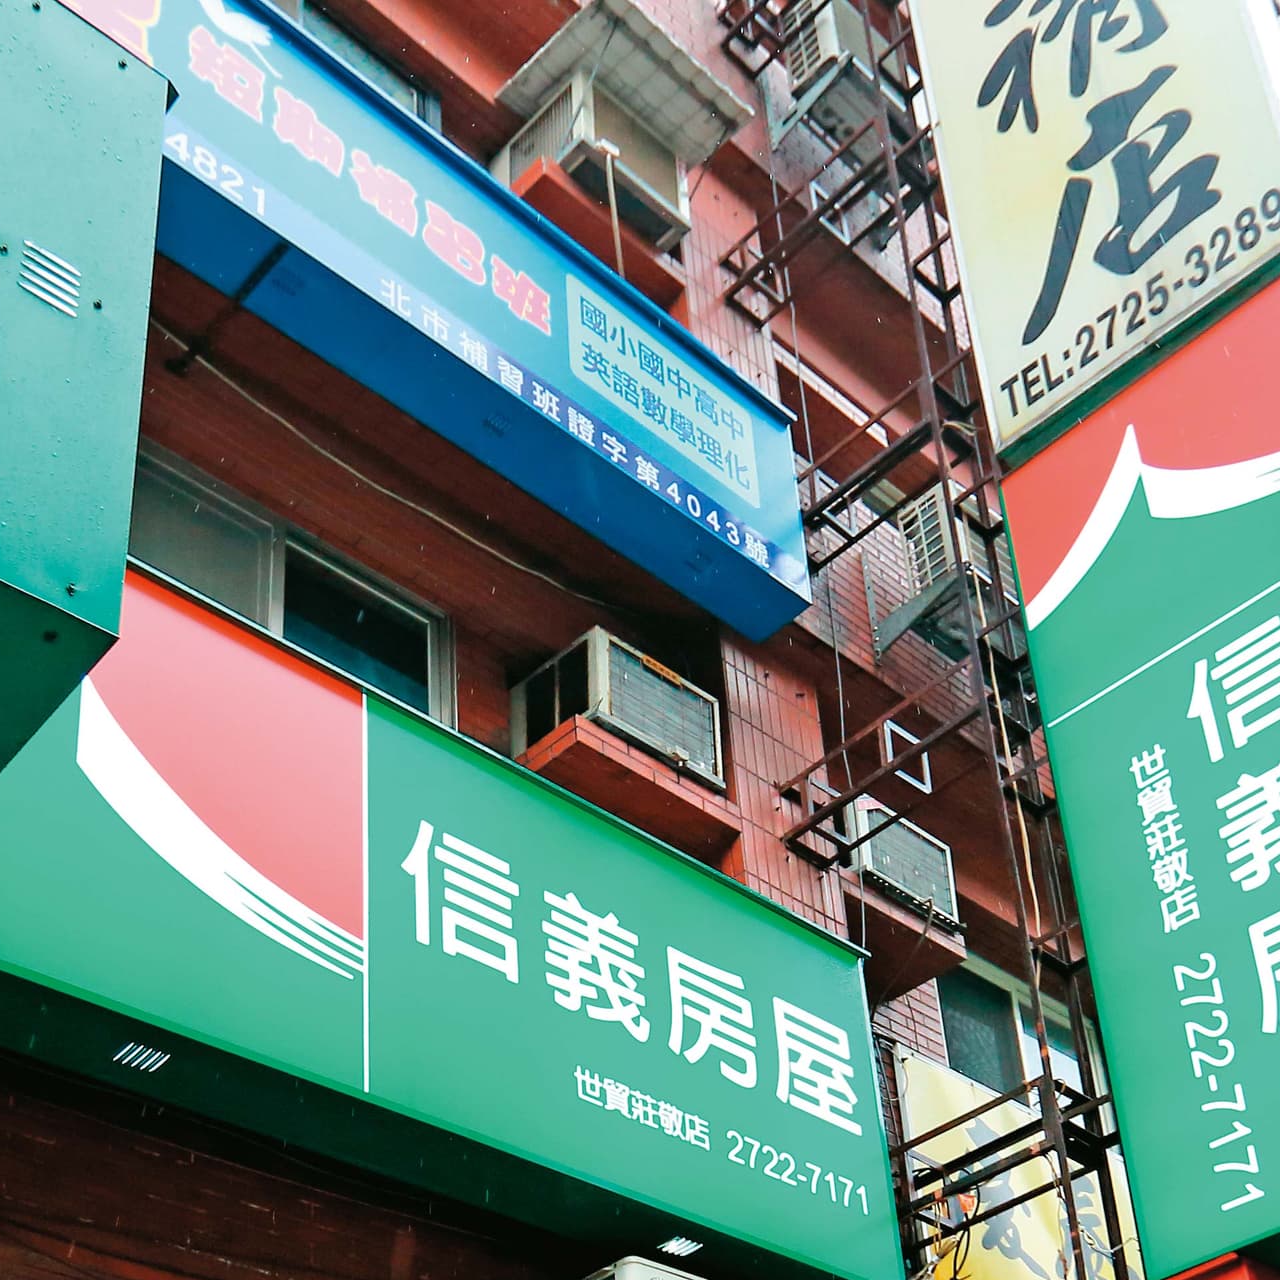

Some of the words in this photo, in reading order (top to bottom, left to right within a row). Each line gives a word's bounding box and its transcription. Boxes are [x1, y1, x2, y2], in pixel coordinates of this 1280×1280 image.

[164, 132, 267, 216] 4821
[380, 278, 770, 570] 北市補習班證字第4043號
[579, 295, 746, 442] 國小國中高中
[581, 342, 751, 491] 英語數學理化
[400, 819, 863, 1137] 信義房屋
[1129, 743, 1201, 934] 世貿莊敬店
[1174, 952, 1265, 1212] 2722-7171
[573, 1064, 711, 1151] 世貿莊敬店
[726, 1130, 869, 1216] 2722-7171
